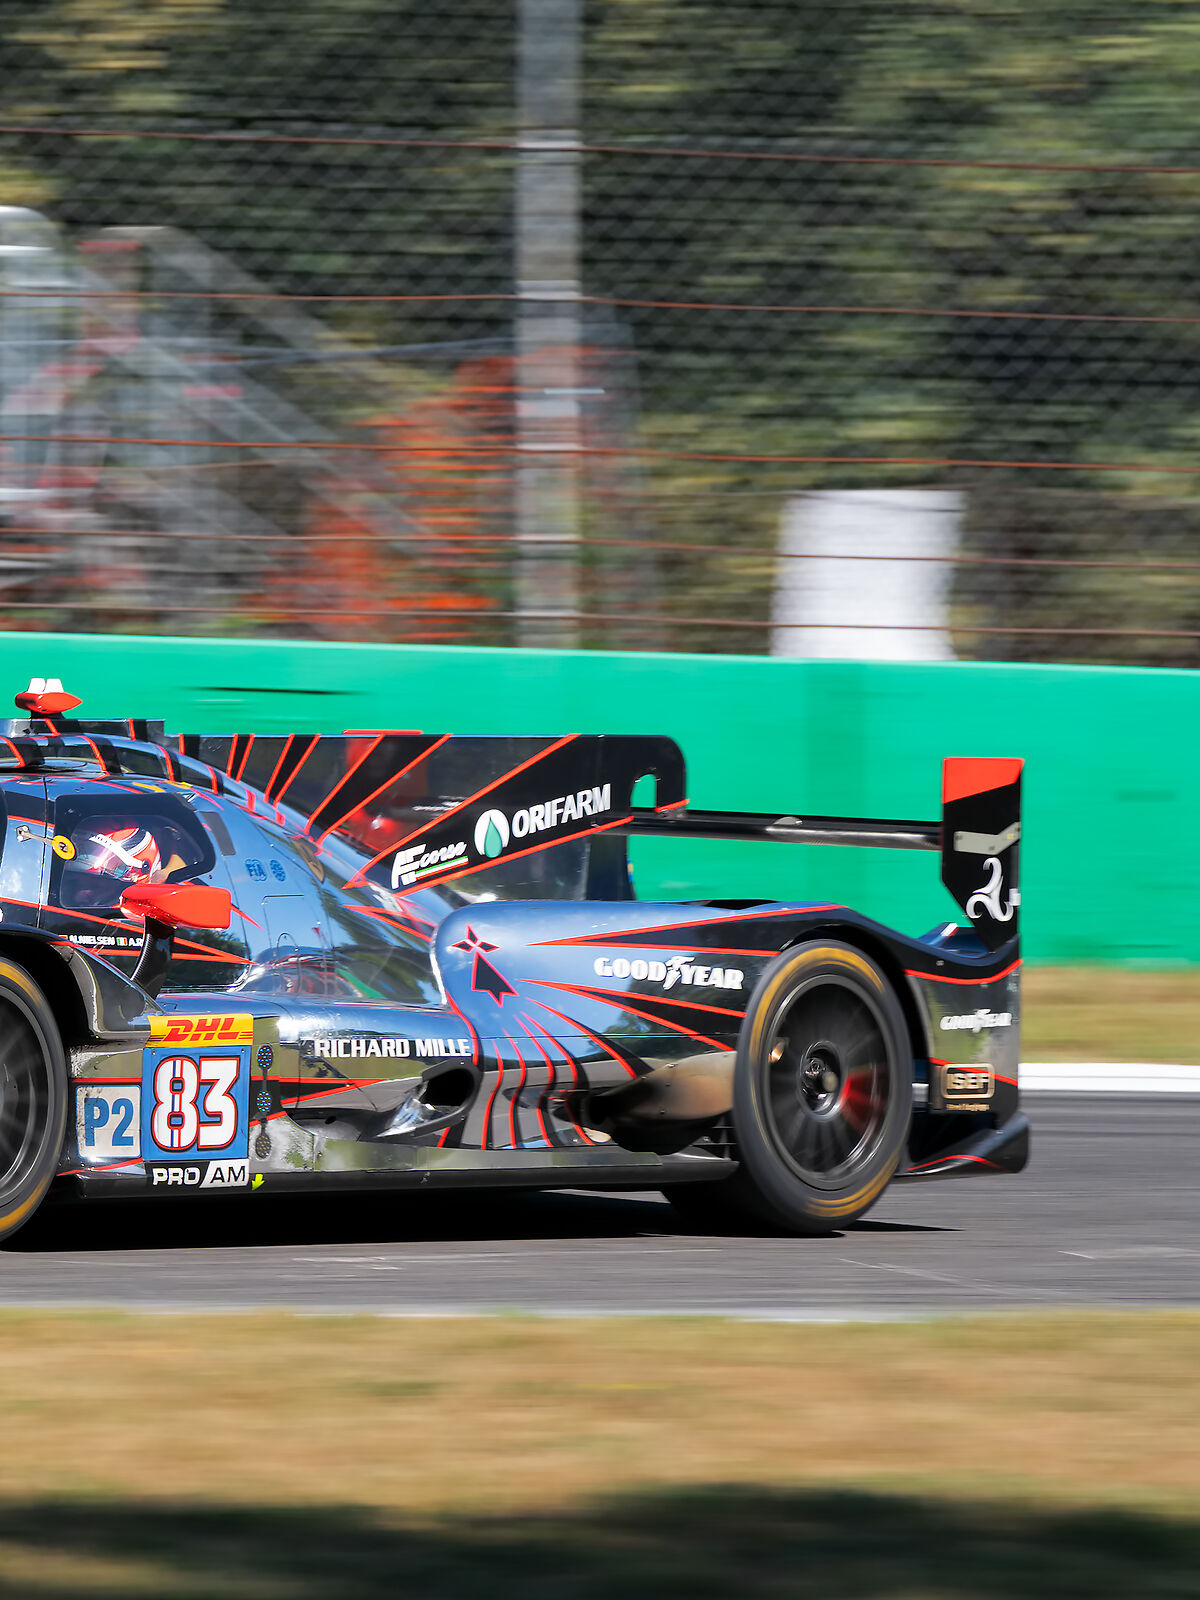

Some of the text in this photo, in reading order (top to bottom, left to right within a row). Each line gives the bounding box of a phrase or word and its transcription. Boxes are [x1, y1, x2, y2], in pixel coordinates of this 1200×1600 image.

[511, 783, 611, 838] ORIFARM
[593, 956, 745, 990] GOODYEAR
[163, 1017, 239, 1042] DHL
[314, 1038, 472, 1058] RICHARD MILLE
[150, 1055, 240, 1153] 83
[84, 1097, 134, 1147] P2
[152, 1165, 246, 1186] PRO AM
